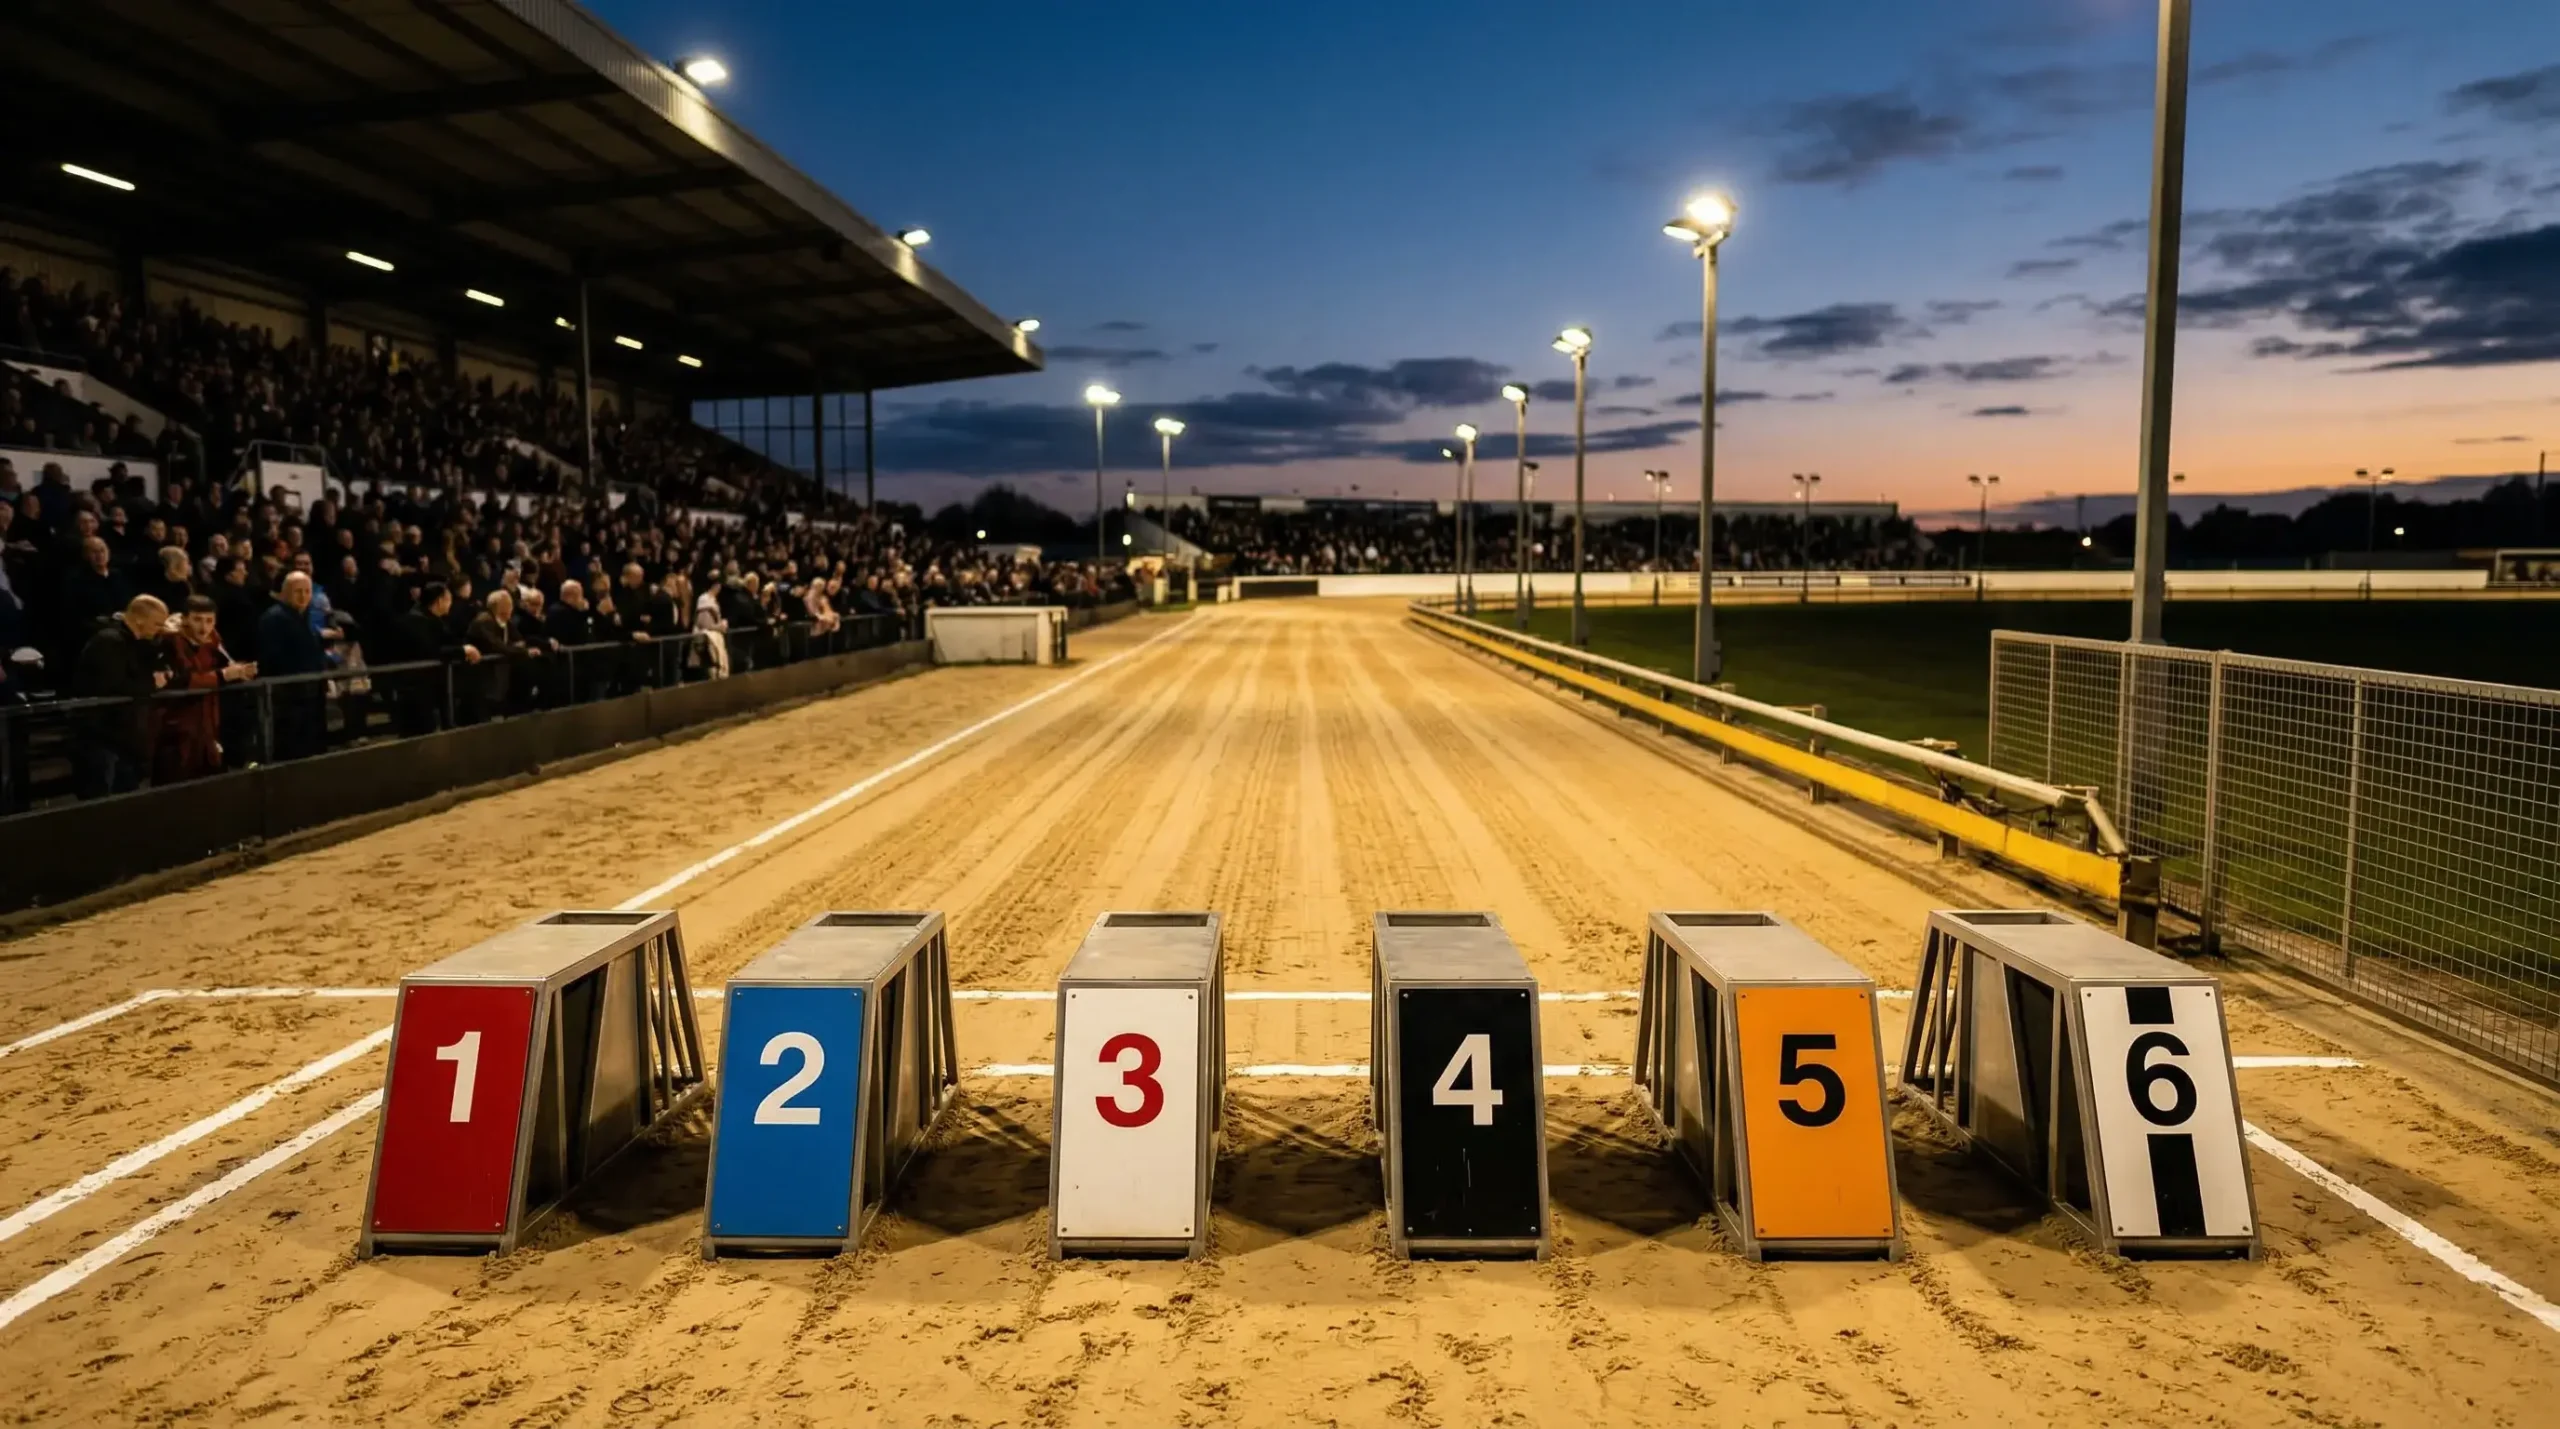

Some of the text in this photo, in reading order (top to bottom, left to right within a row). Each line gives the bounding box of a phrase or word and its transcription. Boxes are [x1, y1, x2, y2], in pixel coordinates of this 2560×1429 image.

[436, 1032, 481, 1123] 1
[754, 1032, 825, 1125] 2
[1095, 1032, 1164, 1128] 3
[1432, 1033, 1503, 1126] 4
[1778, 1033, 1846, 1128] 5
[2126, 1031, 2198, 1127] 6
